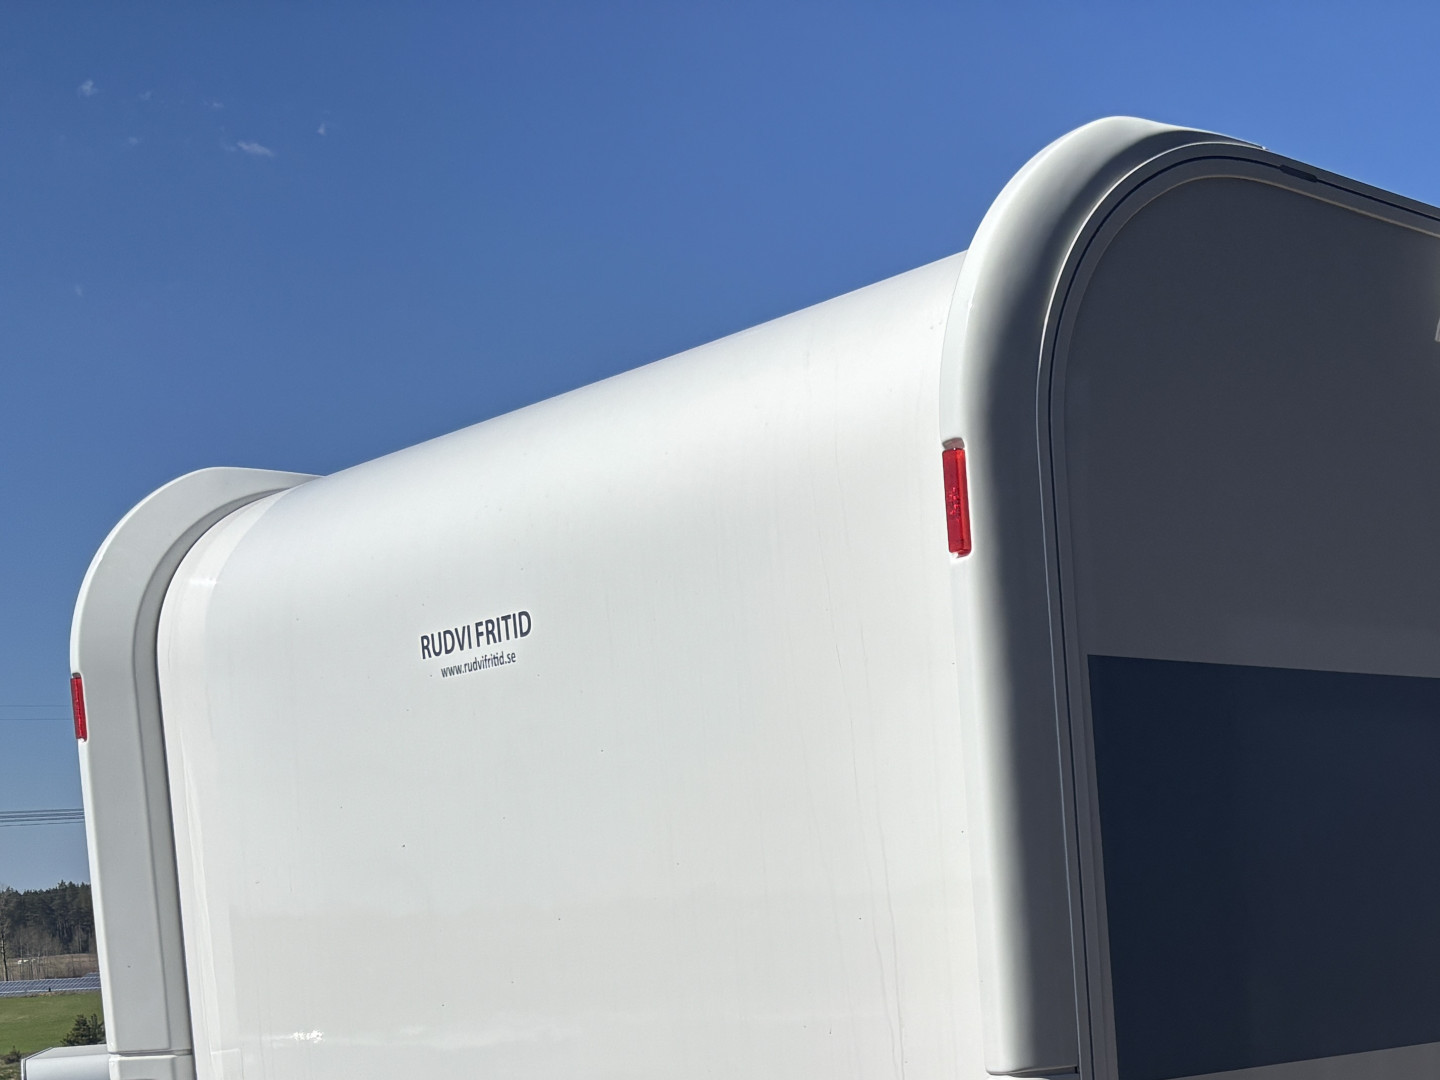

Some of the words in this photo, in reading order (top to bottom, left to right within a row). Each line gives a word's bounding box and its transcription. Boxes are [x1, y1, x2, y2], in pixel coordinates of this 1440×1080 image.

[420, 624, 472, 660] RUDVI
[474, 610, 532, 648] FRITID
[440, 651, 517, 678] www.rudvifritid.se
